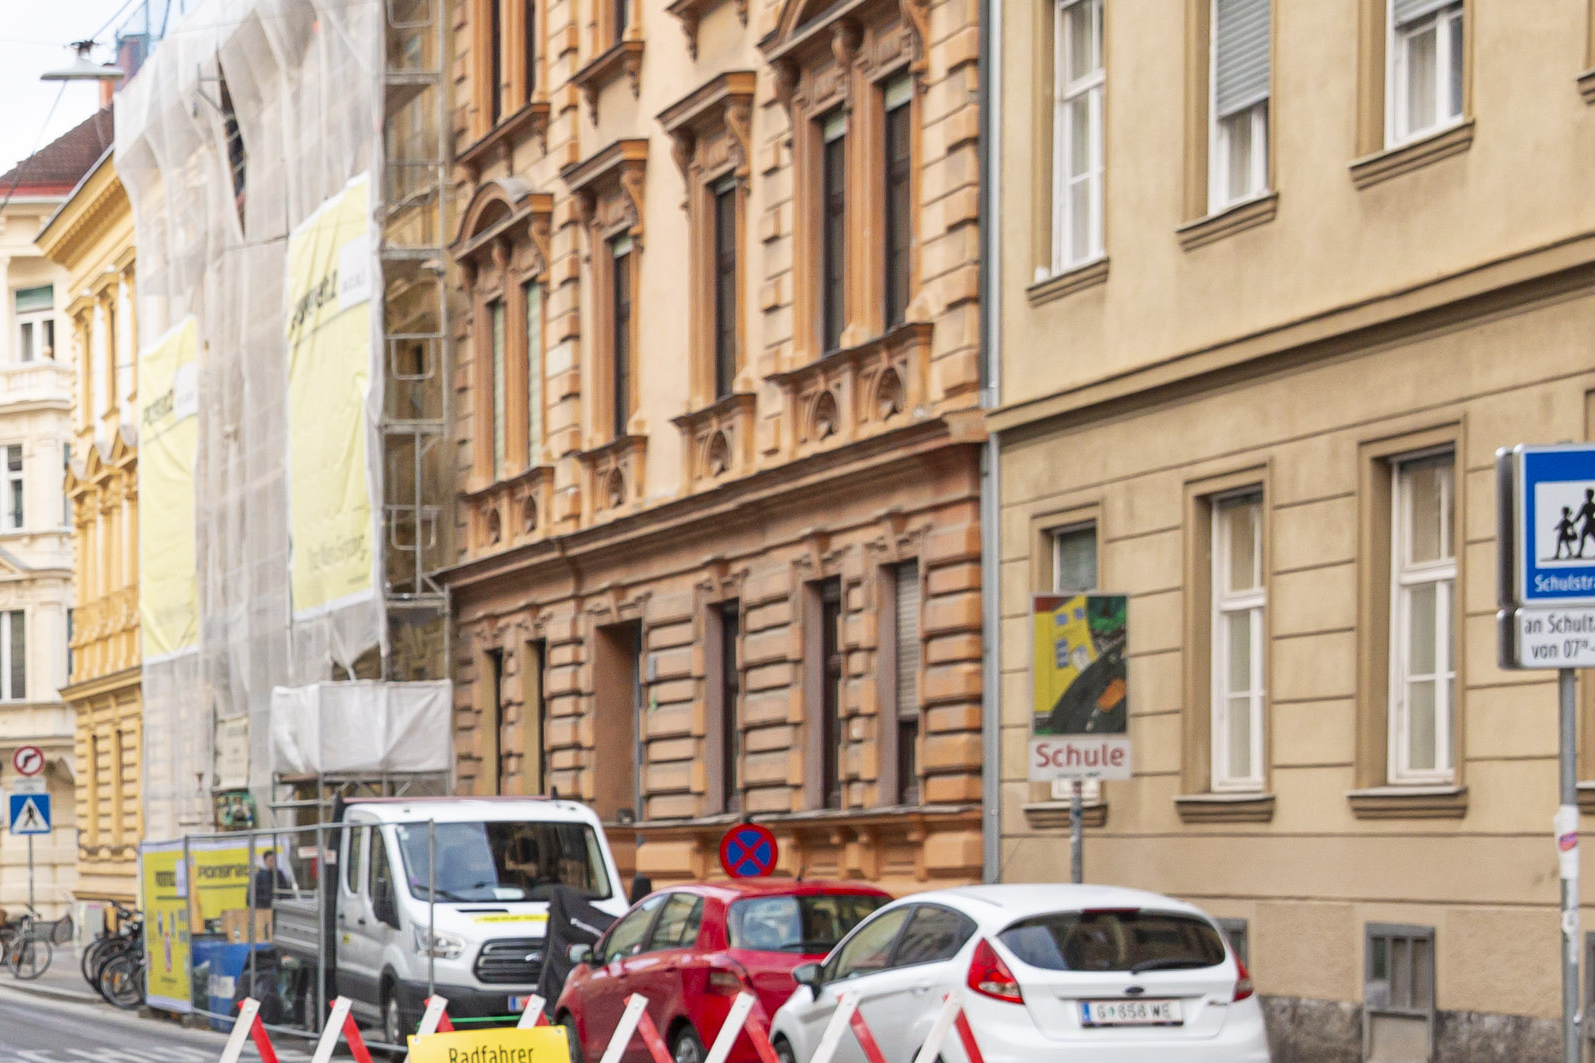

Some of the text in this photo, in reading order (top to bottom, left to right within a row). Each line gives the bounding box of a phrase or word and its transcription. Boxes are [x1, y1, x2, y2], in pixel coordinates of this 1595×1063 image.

[1534, 573, 1595, 592] Schulstr
[1524, 613, 1595, 634] an Schult
[1531, 643, 1558, 659] von
[1035, 743, 1125, 768] Schule
